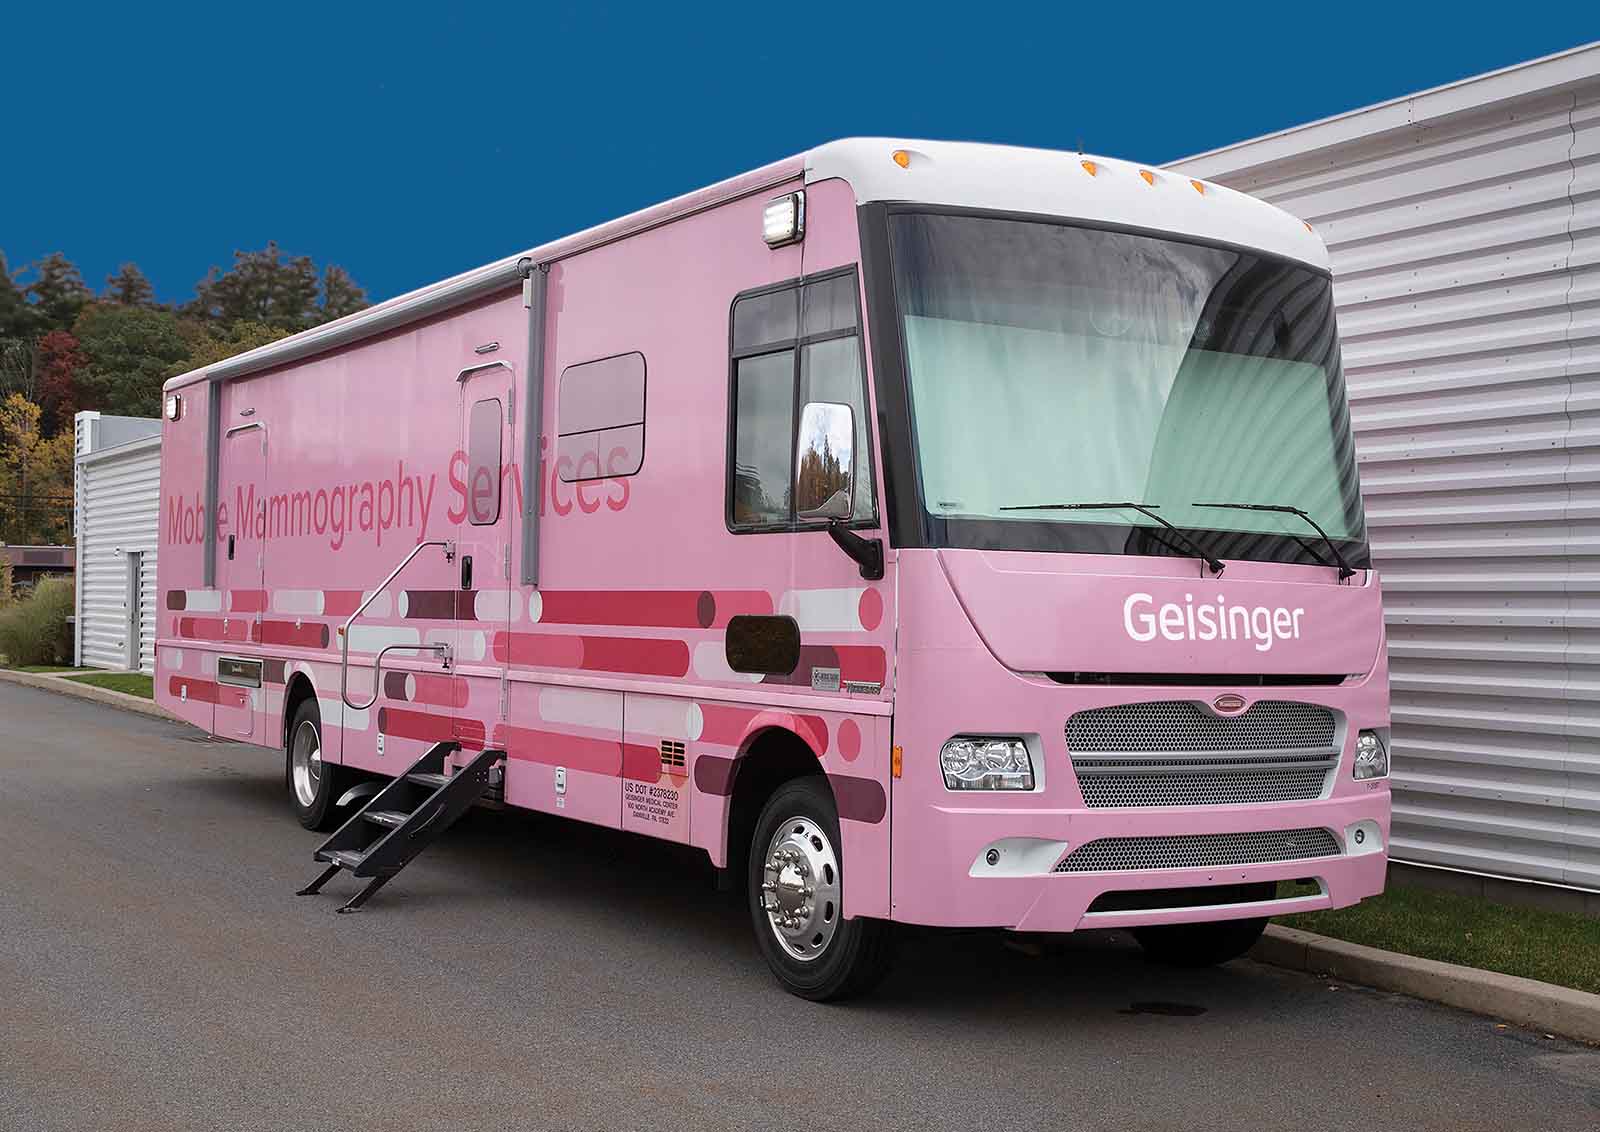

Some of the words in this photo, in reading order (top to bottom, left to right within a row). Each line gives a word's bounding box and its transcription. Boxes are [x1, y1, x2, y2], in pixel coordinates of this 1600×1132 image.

[167, 491, 228, 545] Mobe
[236, 459, 436, 551] Mammography
[1123, 592, 1305, 652] Geisinger
[624, 782, 633, 793] US
[635, 784, 647, 795] DOT
[646, 797, 662, 806] MEDICAL
[662, 801, 678, 810] CENTER
